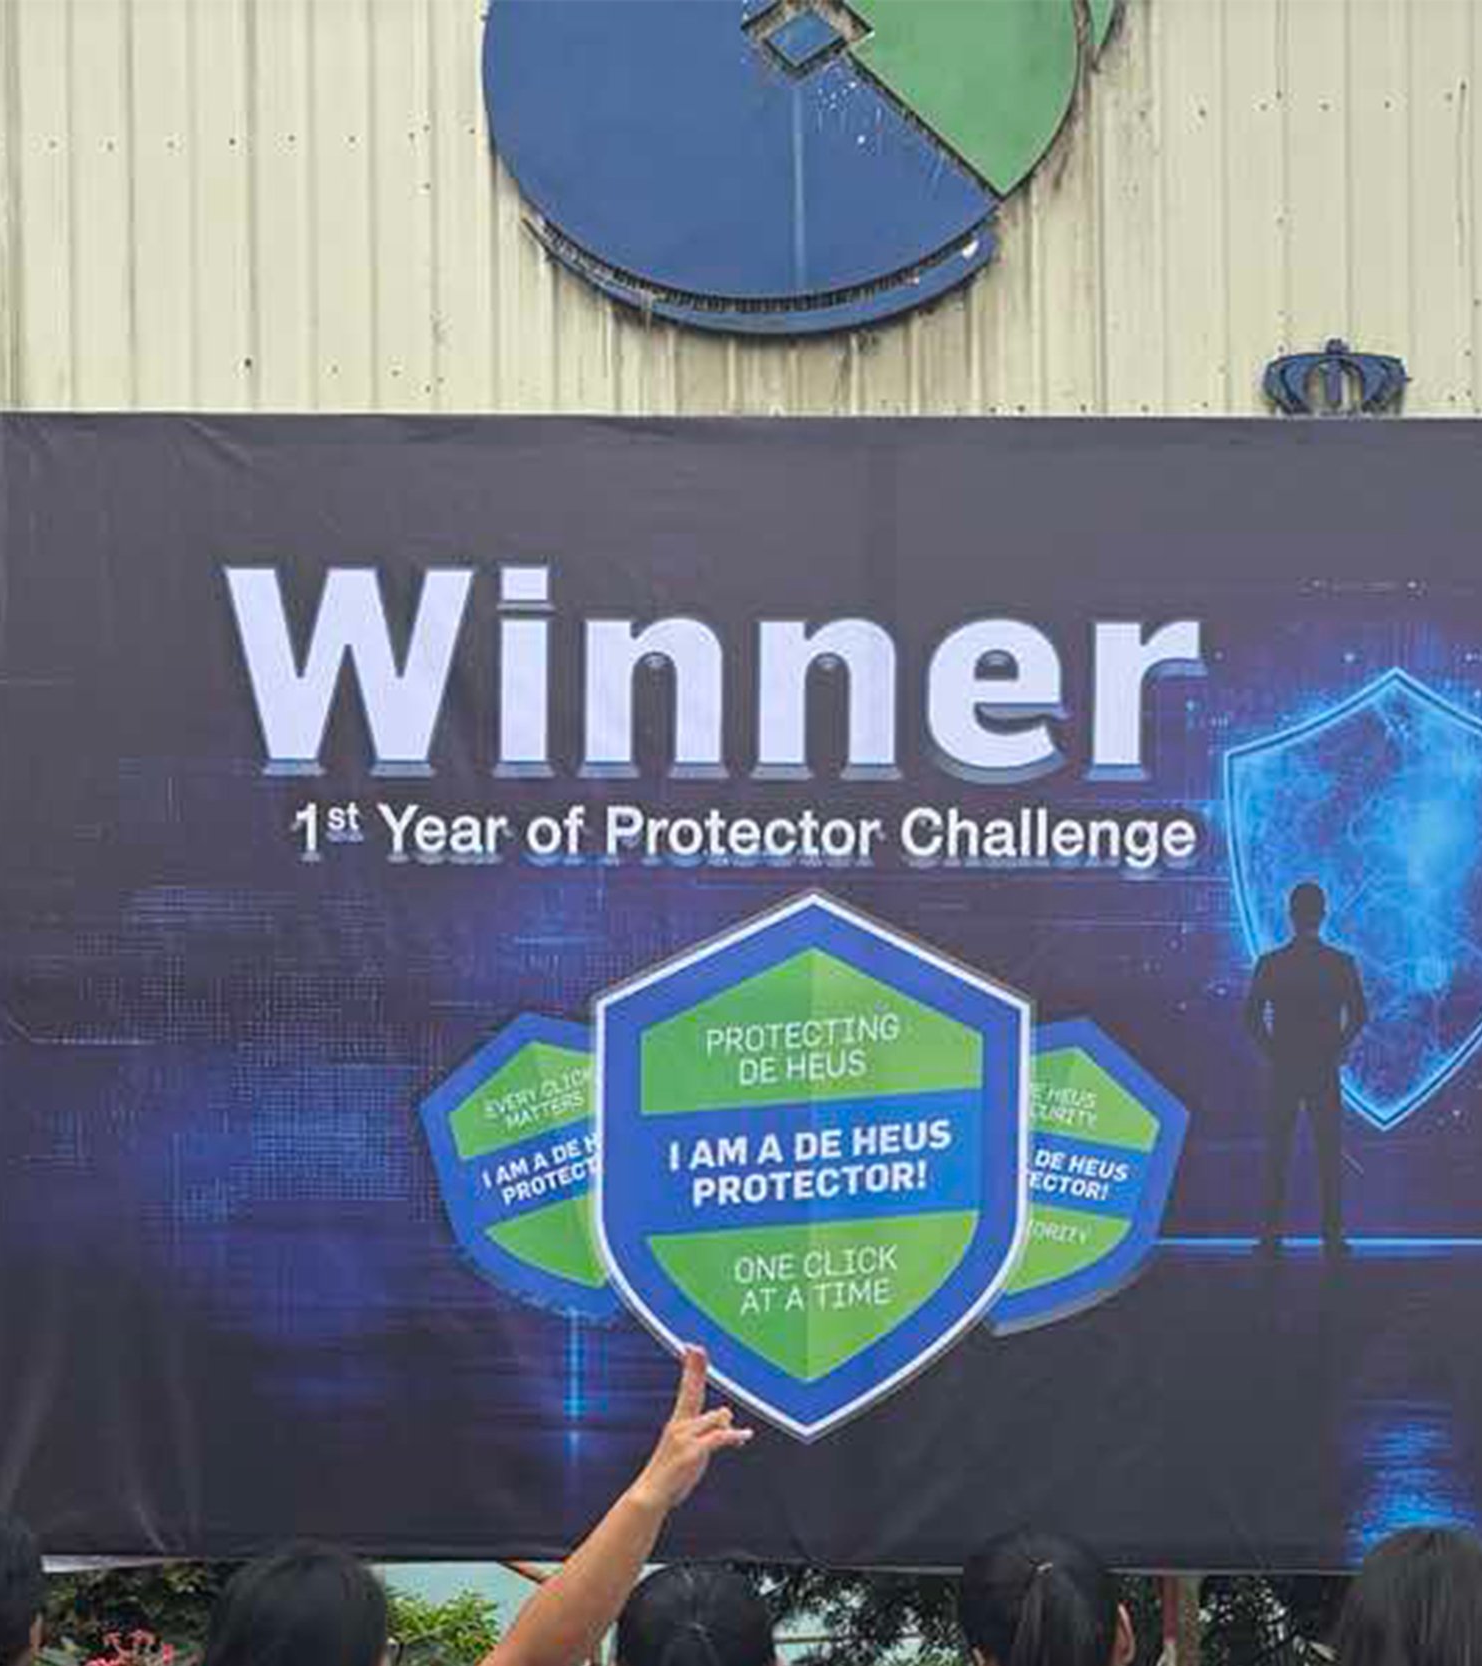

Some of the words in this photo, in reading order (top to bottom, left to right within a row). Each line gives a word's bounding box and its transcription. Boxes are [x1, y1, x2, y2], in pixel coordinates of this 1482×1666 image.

[223, 566, 1203, 770] Winner
[295, 802, 361, 852] 1st
[377, 803, 509, 854] Year
[526, 805, 585, 855] of
[606, 805, 881, 857] Protector
[901, 806, 1197, 868] Challenge
[706, 1012, 900, 1057] PROTECTING
[739, 1057, 777, 1086] DE
[785, 1049, 868, 1082] HEUS
[1046, 1087, 1097, 1110] HEUS
[481, 1169, 493, 1189] I
[495, 1156, 530, 1185] AM
[532, 1152, 550, 1172] A
[551, 1138, 582, 1164] DE
[669, 1140, 680, 1172] I
[688, 1135, 748, 1170] AM
[756, 1133, 784, 1165] A
[794, 1129, 842, 1163] DE
[851, 1118, 953, 1157] HEUS
[1033, 1149, 1065, 1171] DE
[1068, 1154, 1128, 1182] HEUS
[692, 1159, 928, 1209] PROTECTOR!
[1028, 1170, 1108, 1201] ECTOR!
[734, 1253, 797, 1285] ONE
[803, 1243, 899, 1280] CLICK
[740, 1287, 777, 1317] AT
[784, 1284, 805, 1312] A
[813, 1277, 893, 1312] TIME
